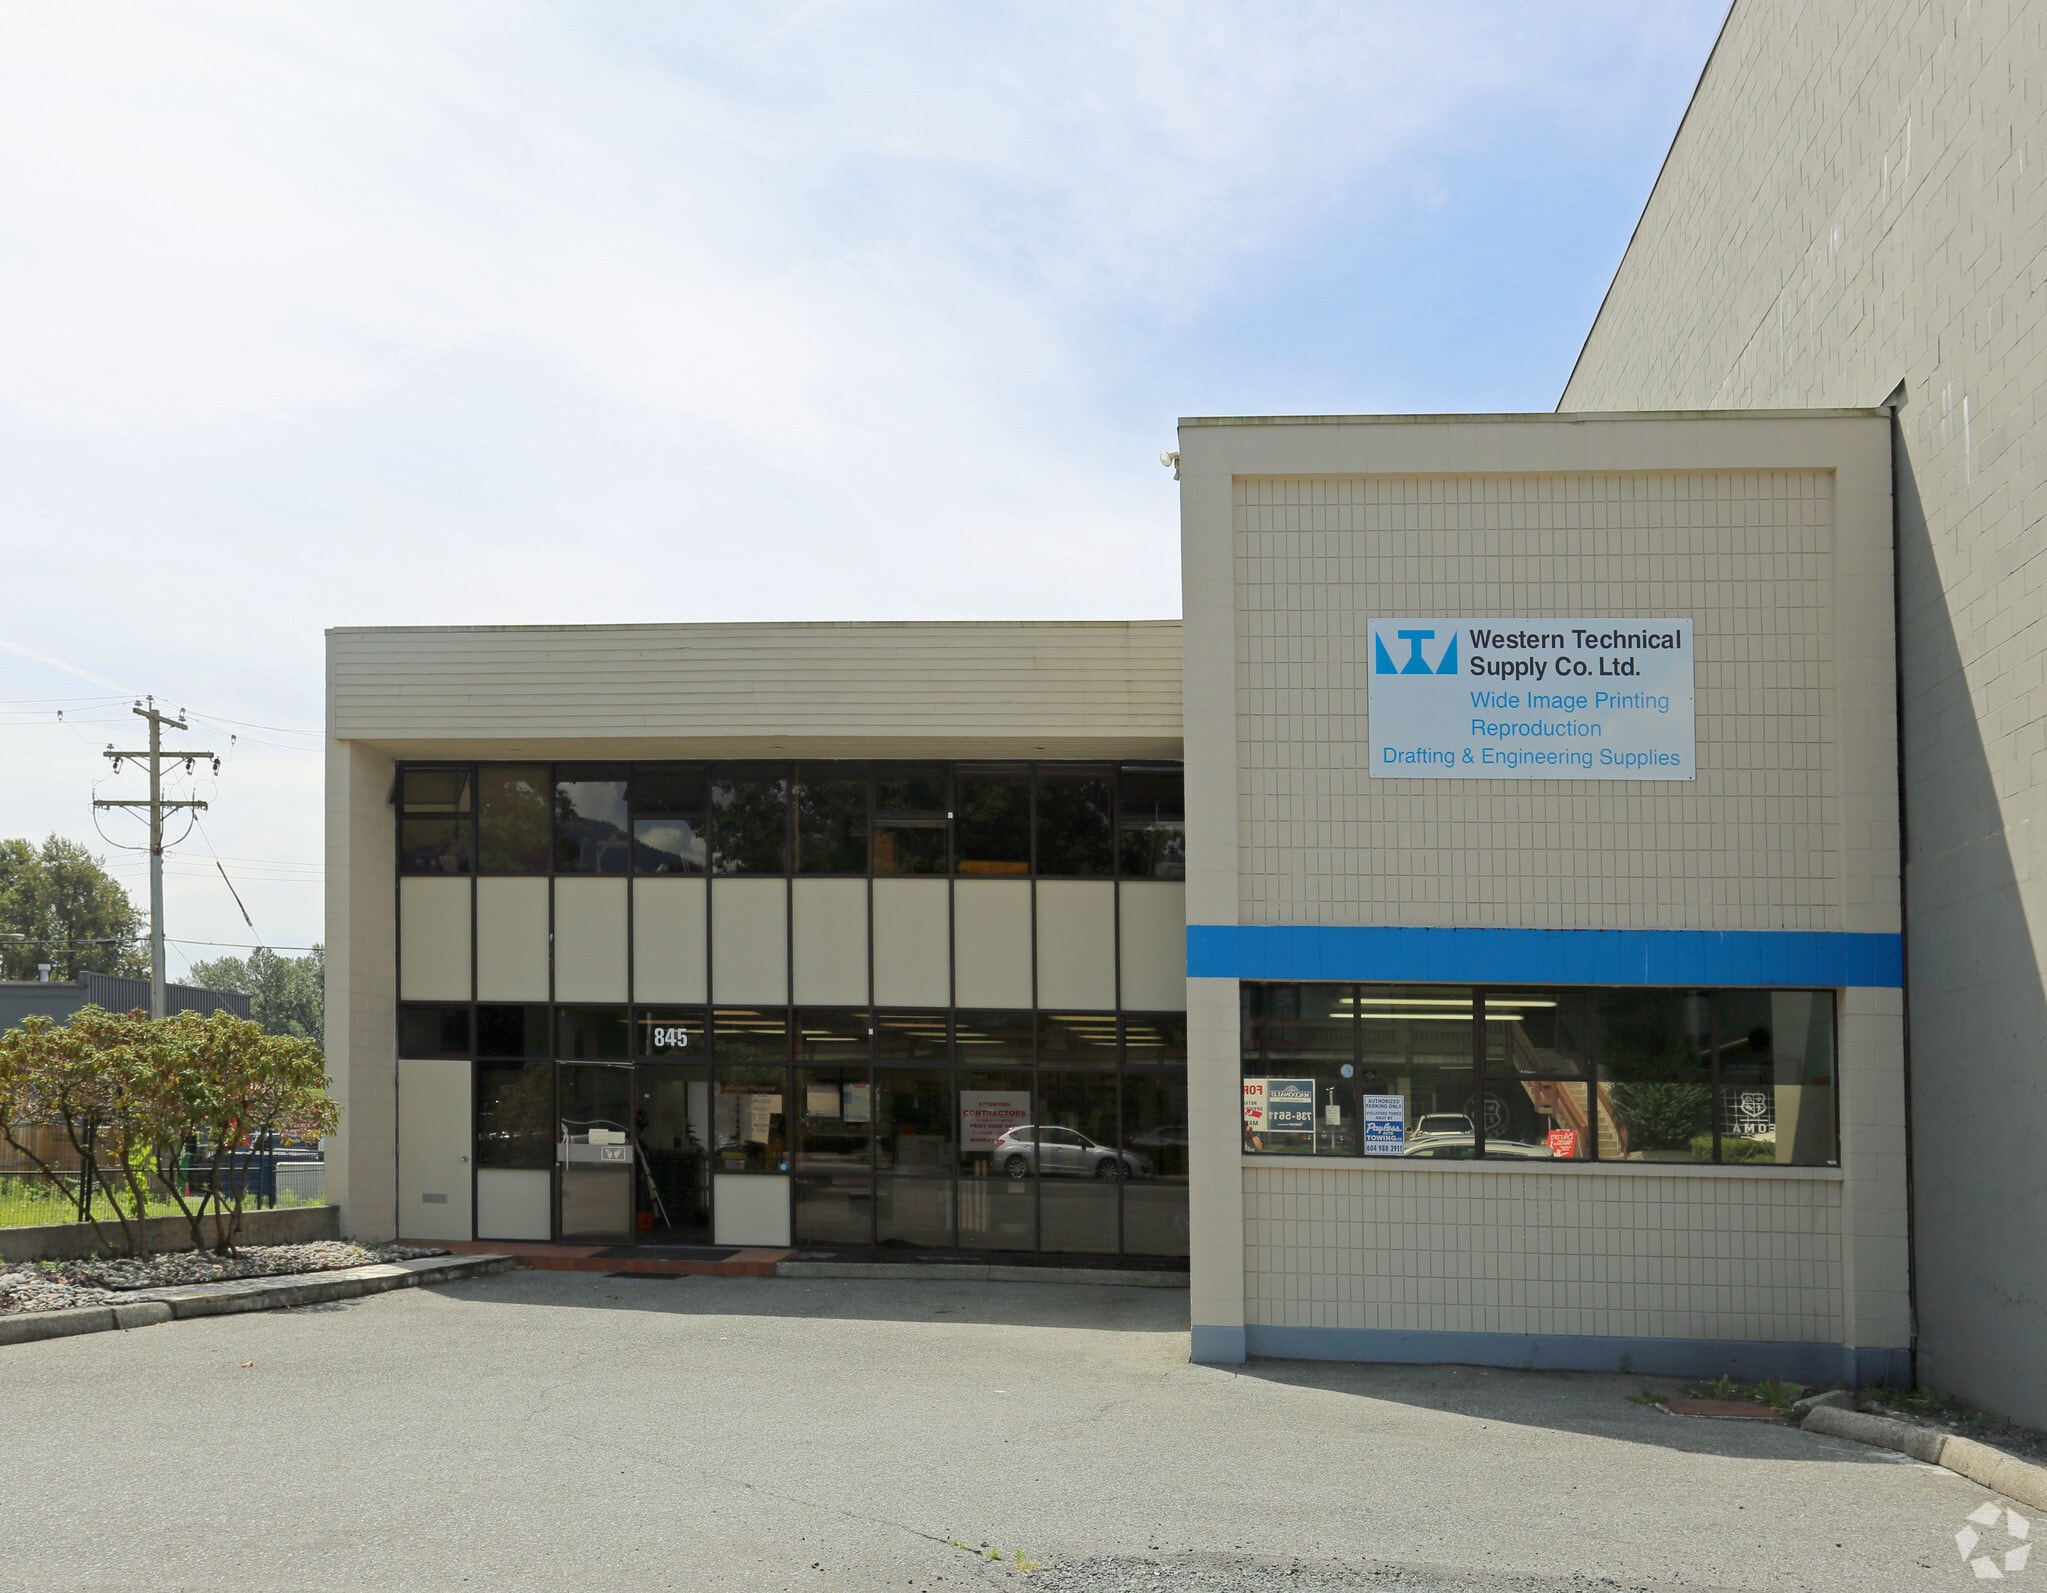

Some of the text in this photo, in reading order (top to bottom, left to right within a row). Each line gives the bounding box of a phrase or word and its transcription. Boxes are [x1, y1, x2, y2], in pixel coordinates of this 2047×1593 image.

[1469, 629, 1682, 649] Western Technical
[1469, 656, 1642, 681] Supply Co. Ltd.
[1470, 691, 1670, 714] Wide Image Printing
[1471, 719, 1602, 740] Reproduction
[1383, 747, 1681, 770] Drafting & Engineering Supplies
[653, 1027, 688, 1048] 845
[1366, 1122, 1402, 1134] Payless
